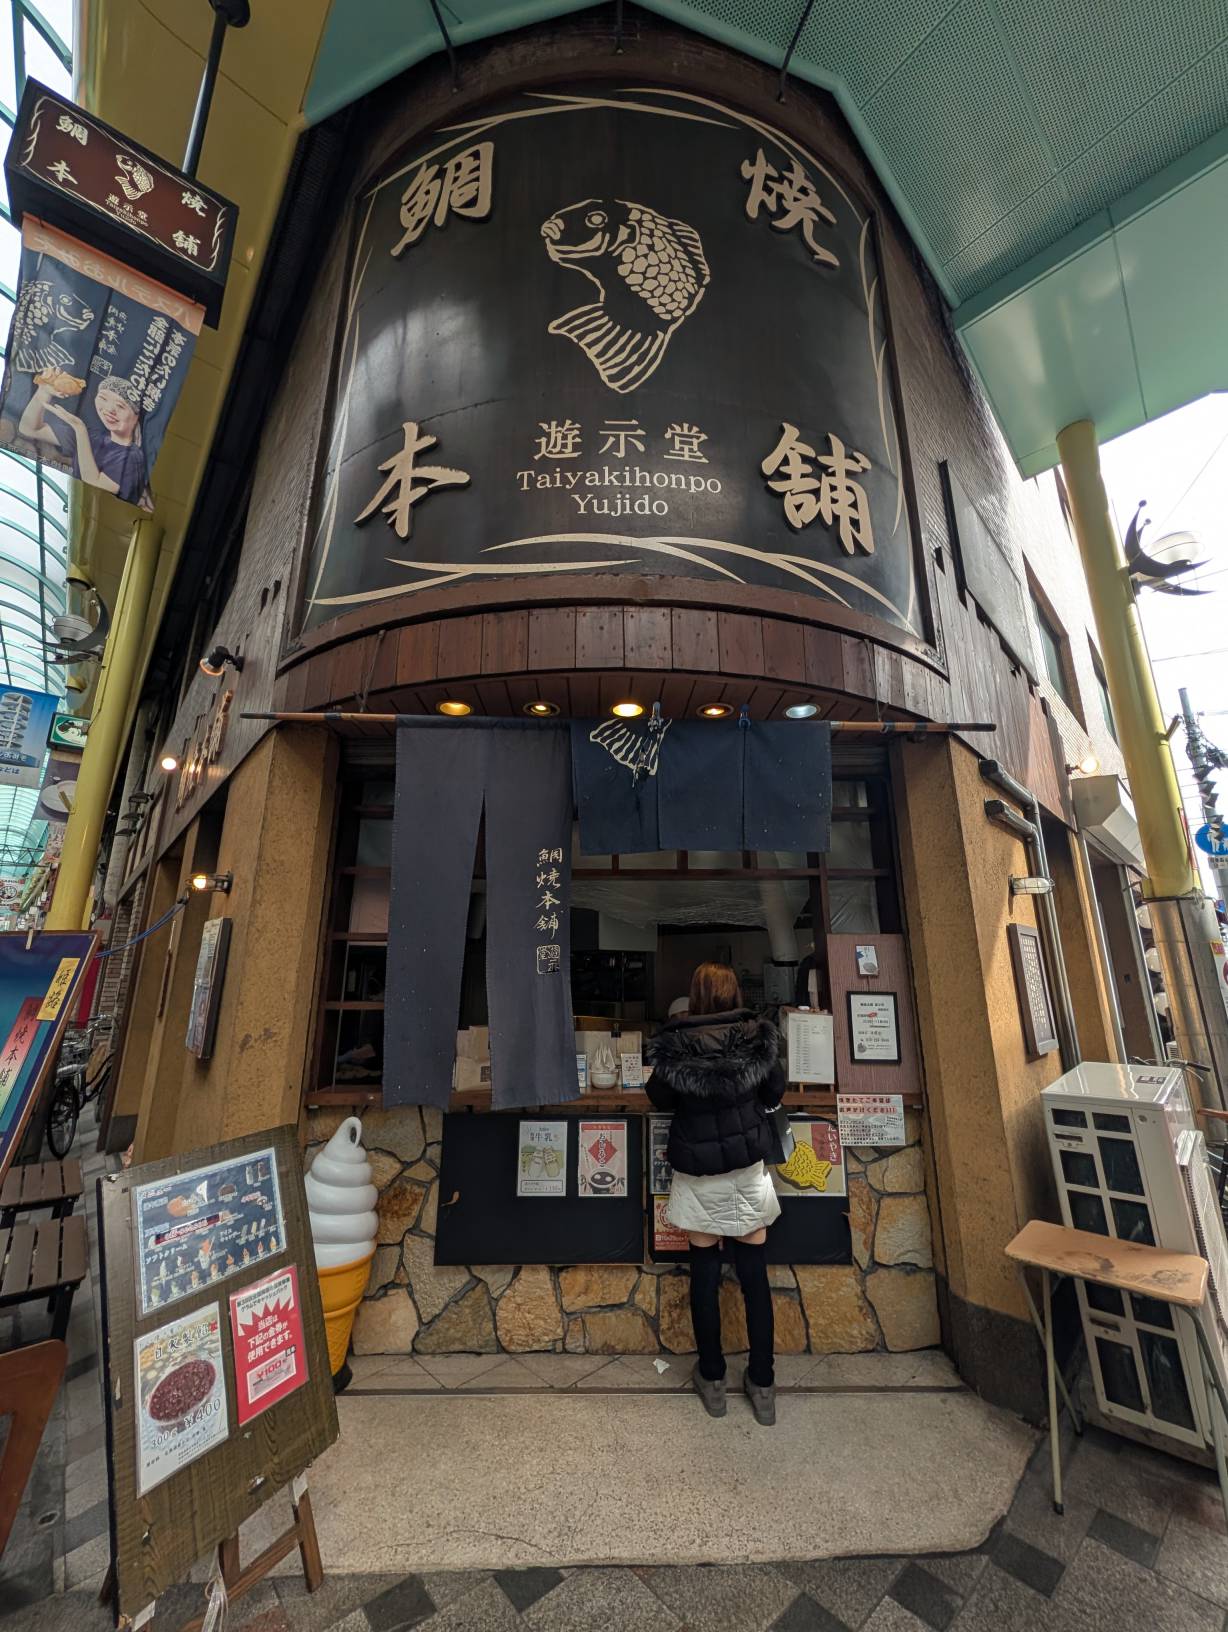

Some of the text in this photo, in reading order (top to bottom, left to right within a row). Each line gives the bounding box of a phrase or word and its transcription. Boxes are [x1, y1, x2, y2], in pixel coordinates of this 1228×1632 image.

[47, 159, 78, 185] 本
[391, 141, 494, 257] 鯛
[533, 419, 709, 463] 遊示堂
[354, 421, 470, 539] 本
[516, 466, 722, 494] Taiyakihonpo
[571, 494, 669, 517] Yujido
